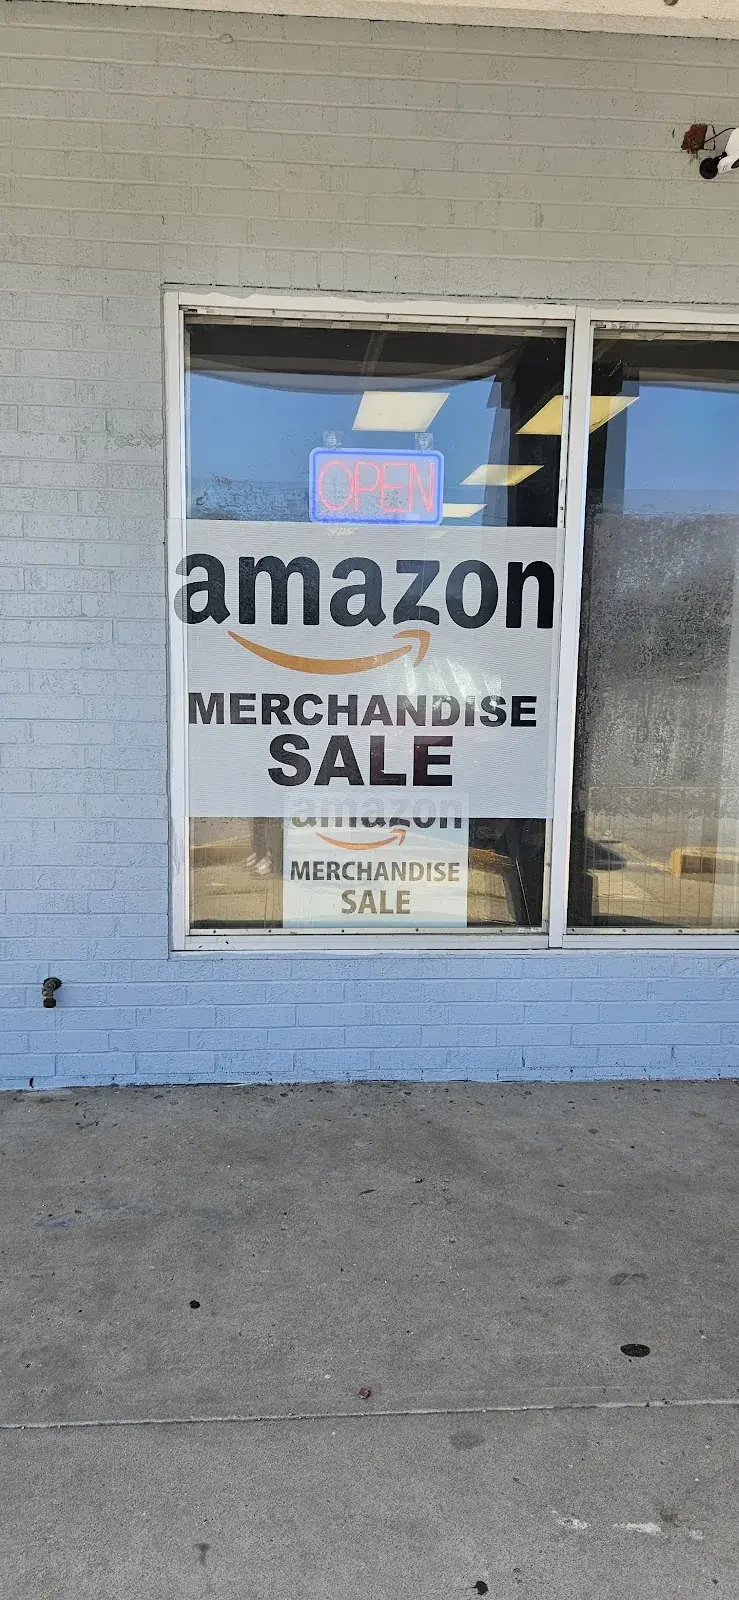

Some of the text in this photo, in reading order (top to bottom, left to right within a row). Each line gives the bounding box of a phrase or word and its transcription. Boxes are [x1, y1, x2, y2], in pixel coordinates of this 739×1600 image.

[317, 460, 435, 513] OPEN
[174, 553, 555, 629] amazon
[188, 692, 538, 728] MERCHANDISE
[267, 733, 453, 787] SALE
[290, 860, 460, 882] MERCHANDISE
[341, 888, 412, 915] SALE
